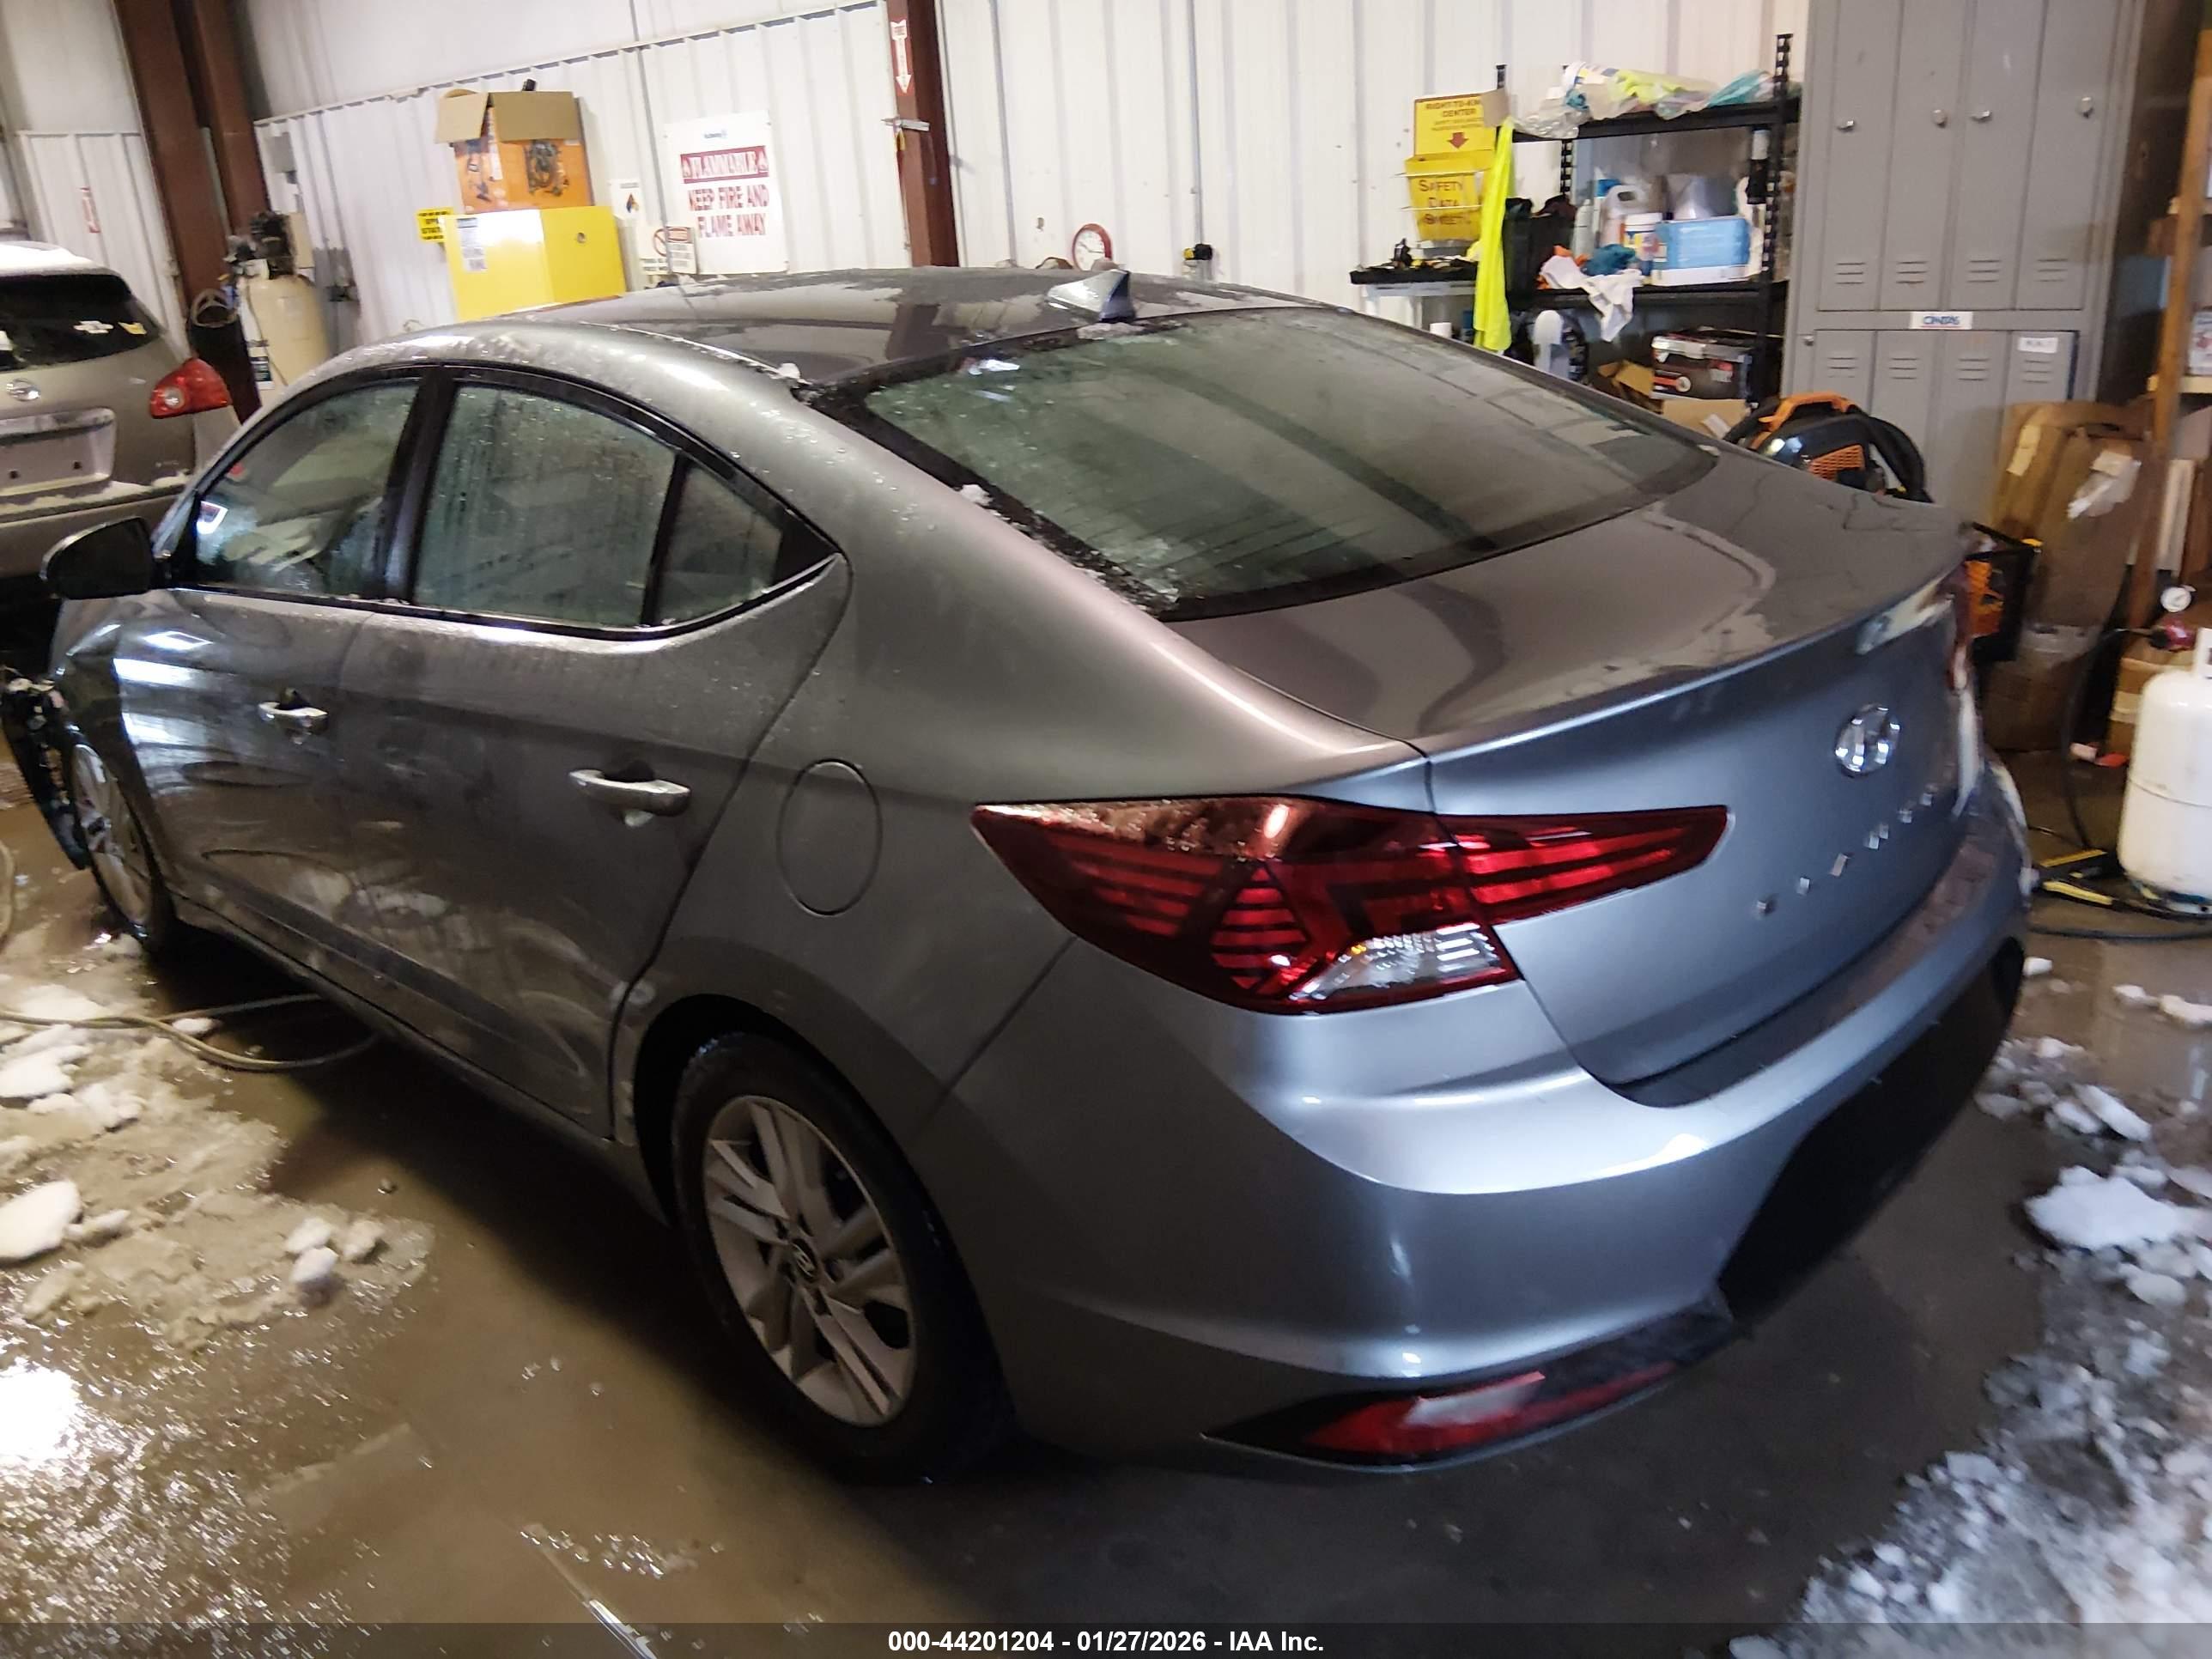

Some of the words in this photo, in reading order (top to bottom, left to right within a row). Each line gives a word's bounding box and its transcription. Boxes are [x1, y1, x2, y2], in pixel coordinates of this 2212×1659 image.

[1425, 100, 1481, 110] RIGHT-TO-KN
[1442, 108, 1477, 118] CENTER
[1419, 179, 1463, 192] SAFETY
[688, 188, 714, 211] KEEP
[718, 185, 743, 209] FIRE
[746, 184, 769, 207] AND
[1428, 197, 1460, 208] DATA
[697, 215, 734, 238] FLAME
[737, 212, 766, 235] AWAY
